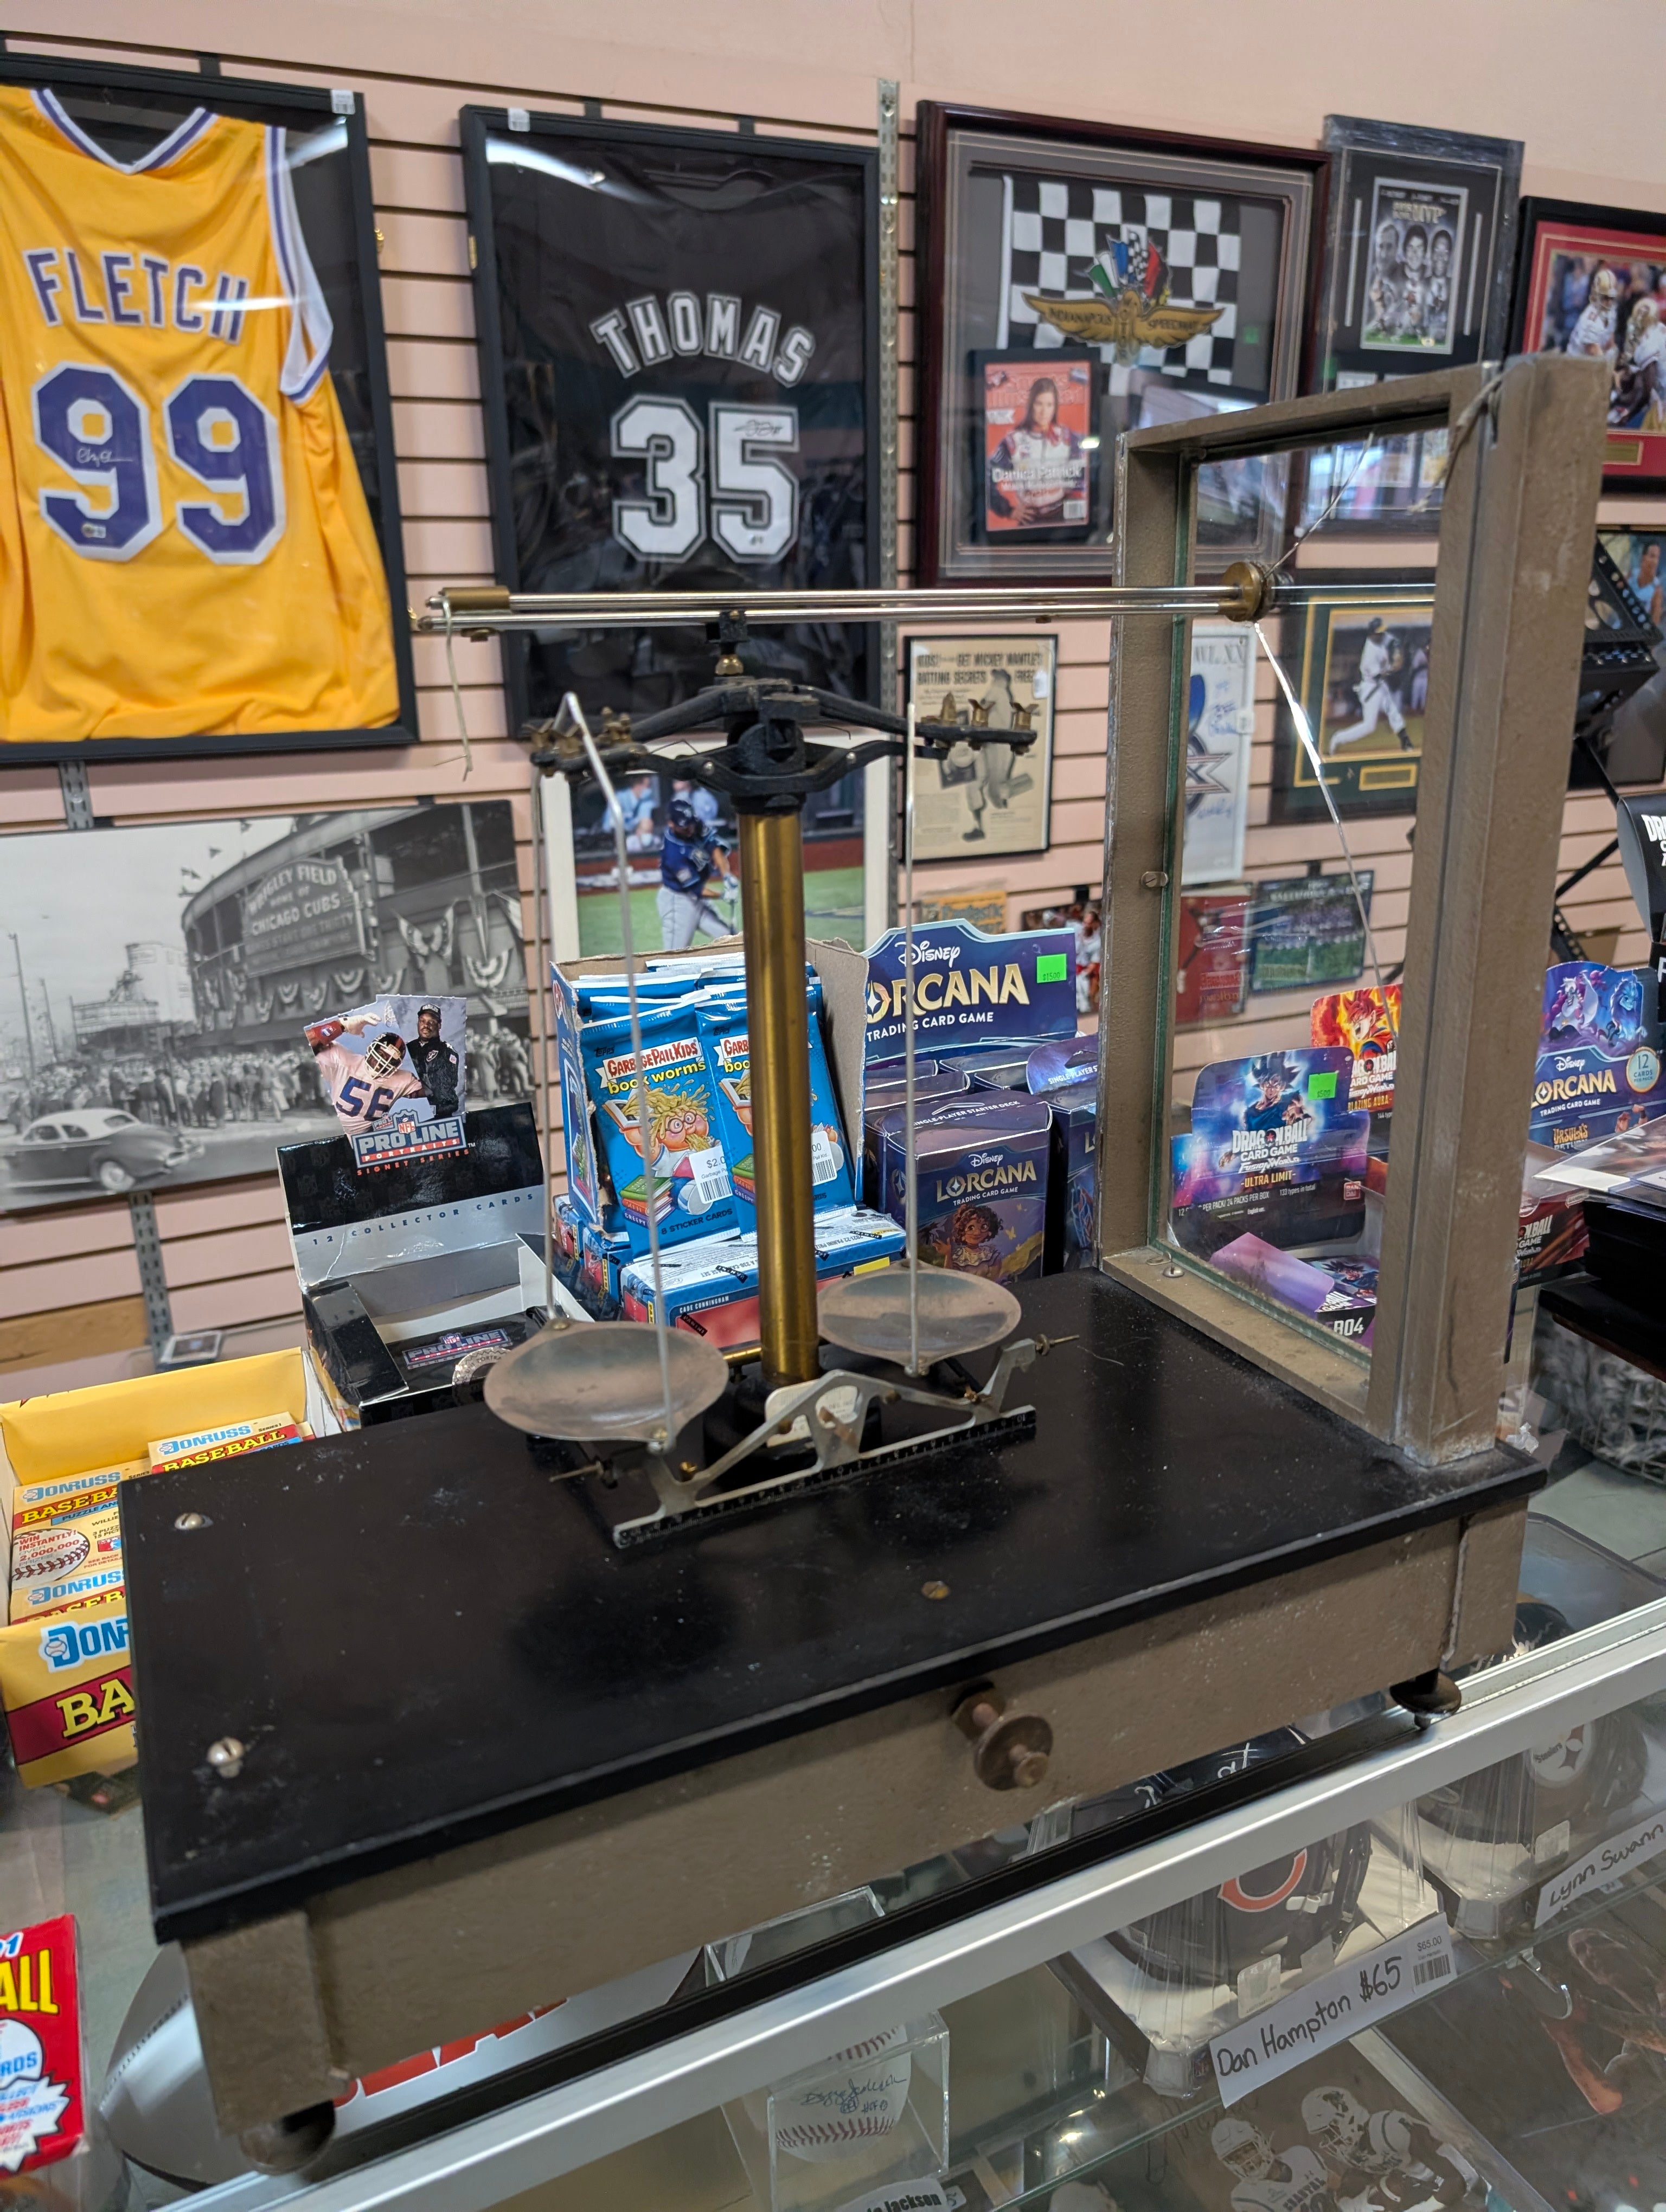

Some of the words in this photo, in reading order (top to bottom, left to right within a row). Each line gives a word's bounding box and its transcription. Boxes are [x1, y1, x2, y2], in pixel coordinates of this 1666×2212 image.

[23, 248, 249, 345] FLETCH
[589, 290, 815, 388] THOMAS
[31, 361, 286, 565] 99
[610, 394, 799, 563] 35
[297, 864, 337, 886] FIELD
[251, 906, 300, 936] CHICAGO
[304, 892, 341, 918] CUBS
[867, 1020, 919, 1041] TRADING
[922, 1015, 955, 1028] CARD
[959, 1012, 994, 1023] GAME
[607, 1051, 653, 1077] GARBGE
[651, 1061, 706, 1083] worms
[1554, 1056, 1585, 1072] Disney
[1637, 1054, 1649, 1070] 12
[1369, 1072, 1393, 1082] GAME
[335, 1076, 394, 1121] 56
[1531, 1069, 1617, 1109] LORCANA
[966, 1104, 999, 1115] STARTER
[999, 1101, 1021, 1109] DECK
[1540, 1104, 1566, 1117] TRADING
[1567, 1101, 1582, 1109] CARD
[360, 1134, 404, 1154] PRO
[412, 1122, 459, 1144] LINE
[398, 1122, 415, 1134] NFL
[364, 1140, 459, 1161] PORTRAITS
[969, 1153, 1003, 1167] Disney
[1240, 1149, 1269, 1162] CARD
[1270, 1143, 1298, 1155] GAME
[357, 1161, 408, 1176] SIGNET
[420, 1149, 469, 1163] SERIES
[701, 1169, 721, 1180] Garbage
[937, 1161, 1037, 1203] LORCANA
[953, 1193, 981, 1206] TRADING
[982, 1189, 999, 1199] CARD
[1001, 1186, 1018, 1195] GAME
[1287, 1186, 1299, 1196] types
[1305, 1184, 1316, 1192] total
[1202, 1203, 1212, 1212] PER
[1227, 1199, 1233, 1207] 24
[1234, 1195, 1248, 1205] PACKS
[1249, 1193, 1259, 1202] PER
[1259, 1191, 1270, 1200] BOX
[313, 1235, 333, 1245] 12
[351, 1209, 460, 1237] COLLECTOR
[476, 1193, 533, 1210] CARDS
[625, 1212, 646, 1225] CREEPY
[669, 1216, 704, 1233] STICKER
[706, 1208, 733, 1222] CARDS
[1518, 1236, 1542, 1248] GAME
[679, 1305, 693, 1314] CADE
[695, 1296, 729, 1310] CUNNINGHAM
[682, 1314, 706, 1335] PANINI
[408, 1343, 450, 1358] PRO
[457, 1332, 502, 1347] LINE
[159, 1425, 252, 1455] DONRUSS
[163, 1431, 285, 1472] BASEBALL
[23, 1471, 121, 1502] DONRUSS
[62, 1506, 99, 1521] PUZZLE
[20, 1534, 40, 1545] WIN
[20, 1529, 77, 1551] INSTANTLY!
[20, 1545, 45, 1555] OVER
[28, 1570, 125, 1605] DONRUS
[56, 1679, 135, 1738] BA
[1549, 1864, 1595, 1906] Lynn
[1600, 1824, 1664, 1870] Swann
[1417, 1935, 1442, 1952] $65.00
[1216, 2047, 1258, 2076] Dan
[1260, 1995, 1351, 2059] Hampton
[1359, 1956, 1402, 2002] $65
